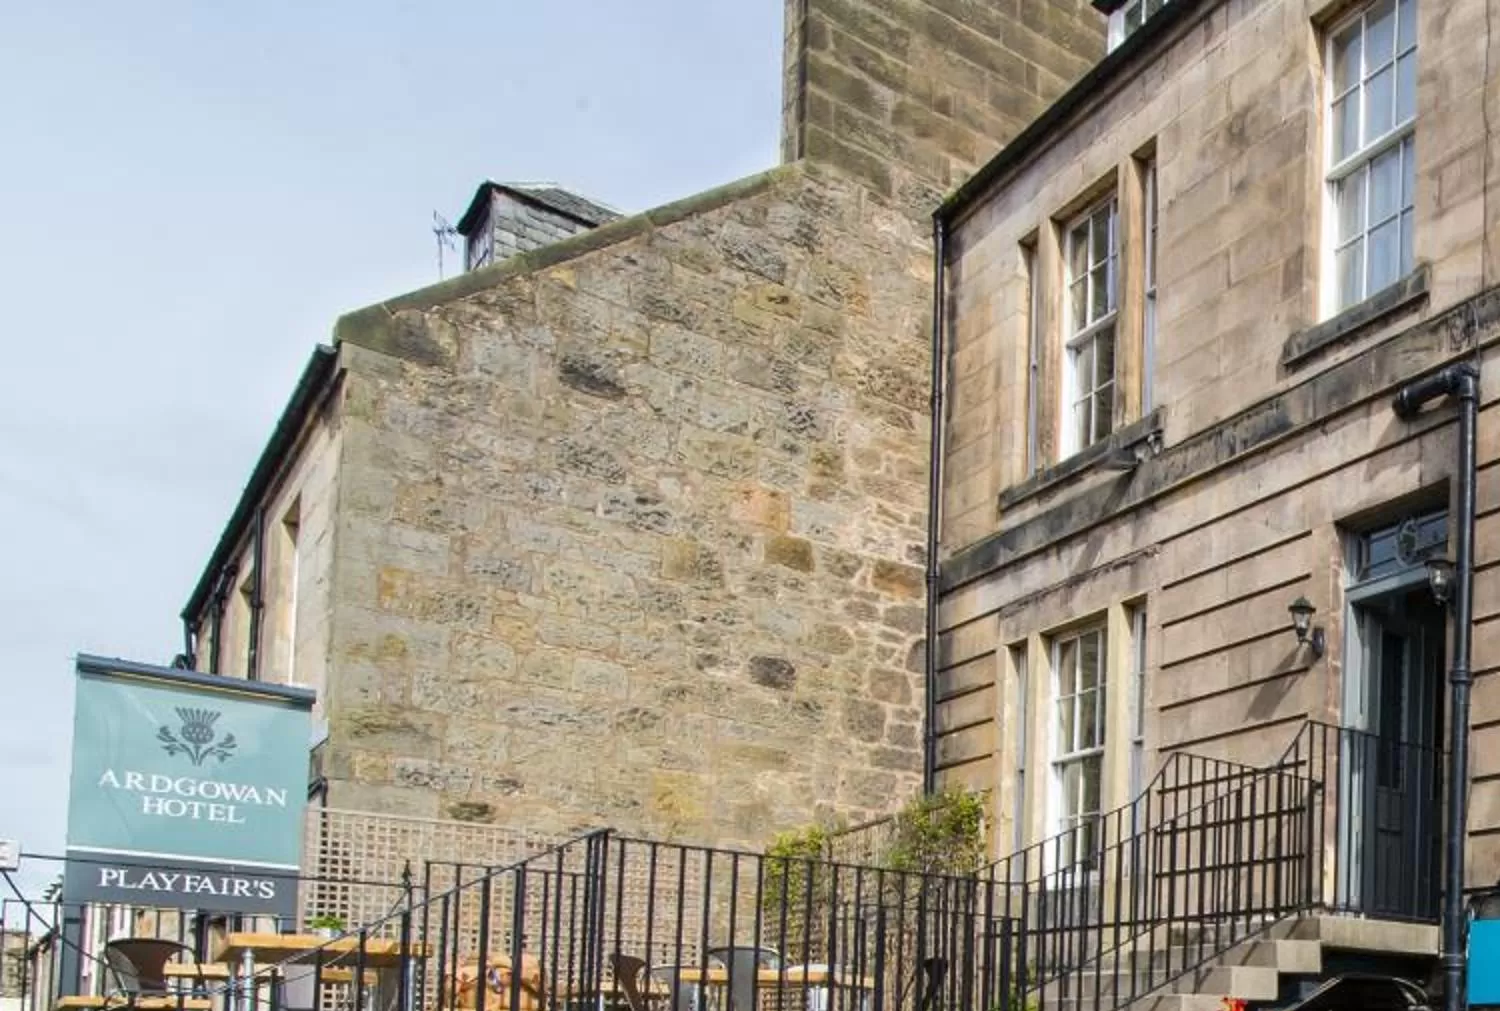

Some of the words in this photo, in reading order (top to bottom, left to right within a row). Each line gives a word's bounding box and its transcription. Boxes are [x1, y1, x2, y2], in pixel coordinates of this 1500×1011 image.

[98, 768, 288, 808] ARDGOWAN
[143, 795, 246, 824] HOTEL
[98, 867, 276, 899] PLAYFAIR'S
